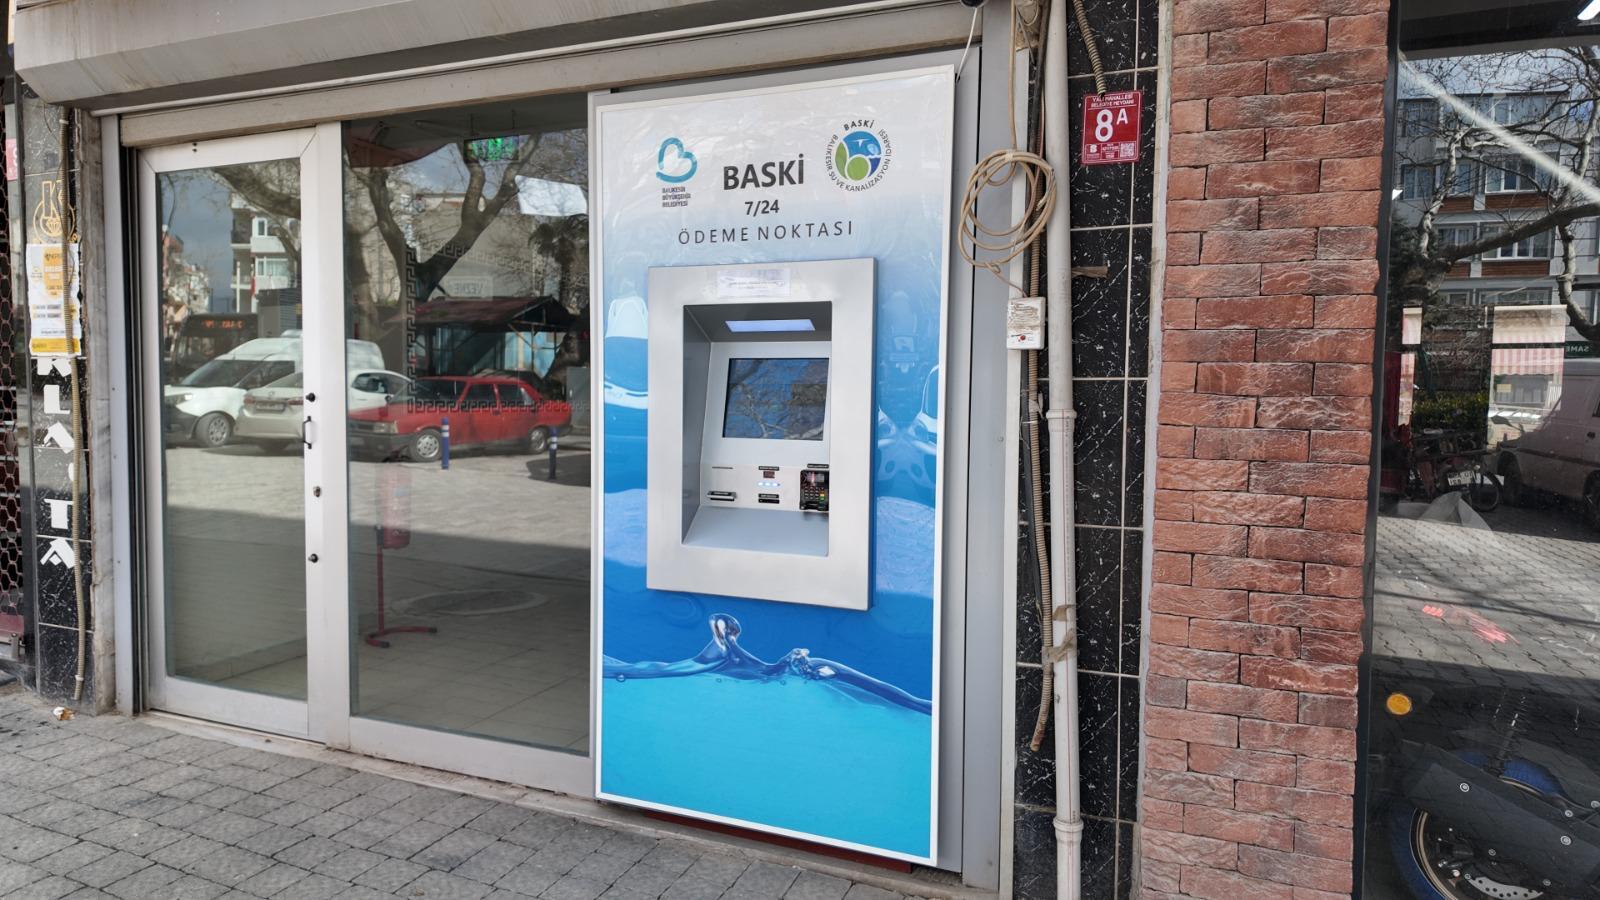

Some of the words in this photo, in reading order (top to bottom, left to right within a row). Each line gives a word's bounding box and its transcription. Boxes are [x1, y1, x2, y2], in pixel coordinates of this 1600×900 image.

[723, 153, 804, 190] BASKİ
[836, 180, 845, 188] VE
[744, 200, 780, 217] 7/24
[678, 227, 749, 245] ÖDEME
[757, 220, 852, 241] NOKTASI
